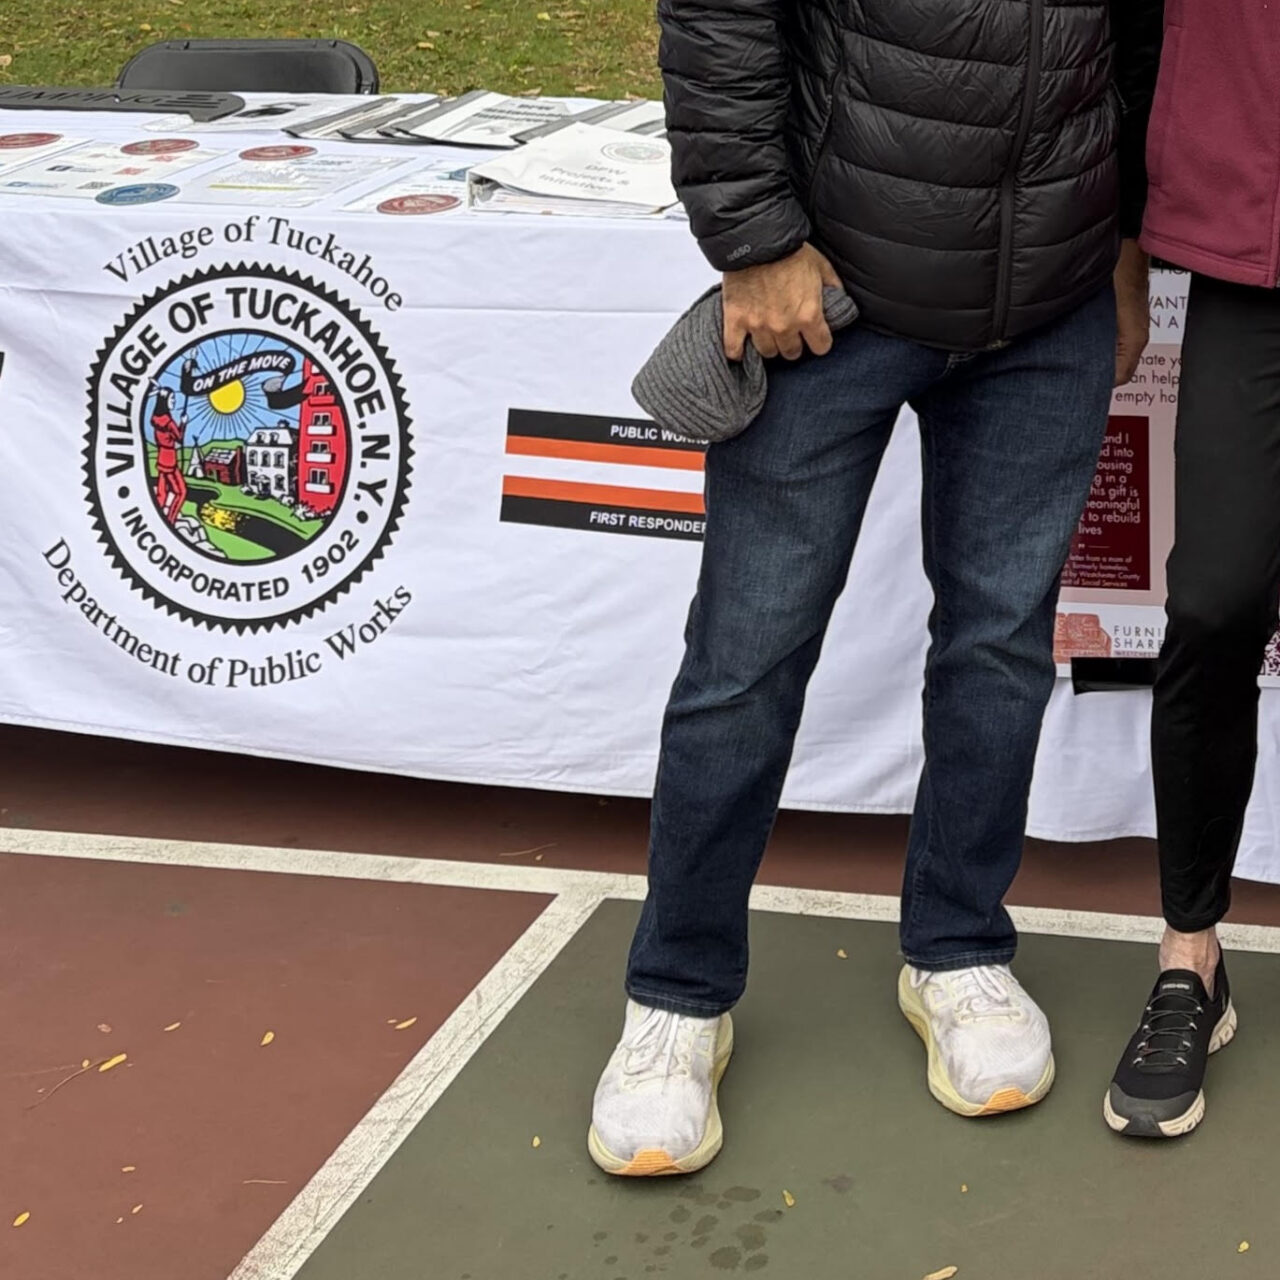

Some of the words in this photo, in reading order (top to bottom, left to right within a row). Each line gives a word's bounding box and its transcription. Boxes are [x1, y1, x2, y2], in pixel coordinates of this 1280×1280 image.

[103, 226, 215, 284] Village
[223, 215, 260, 243] of
[267, 216, 403, 312] Tuckahoe
[1167, 315, 1179, 329] A
[1139, 354, 1166, 366] nate
[192, 375, 215, 392] ON
[218, 360, 248, 383] THE
[248, 354, 292, 372] MOVE
[1151, 370, 1180, 389] help
[105, 324, 168, 478] VILLAGE
[168, 292, 215, 334] OF
[1114, 390, 1155, 407] empty
[1160, 389, 1177, 404] ho
[610, 424, 658, 441] PUBLIC
[1113, 446, 1134, 458] into
[1096, 460, 1133, 474] ousing
[1105, 472, 1116, 484] in
[1090, 483, 1106, 497] his
[1108, 484, 1127, 501] gift
[1129, 485, 1139, 498] is
[589, 511, 626, 527] FIRST
[1088, 511, 1099, 522] to
[1102, 510, 1141, 524] rebuild
[1078, 522, 1103, 536] lives
[121, 506, 290, 602] INCORPORATED
[301, 529, 360, 584] 1902
[41, 536, 182, 677] Department
[187, 657, 223, 686] of
[225, 649, 323, 689] Public
[322, 584, 413, 661] Works
[1113, 625, 1161, 637] FURNI
[1113, 637, 1163, 649] SHARE
